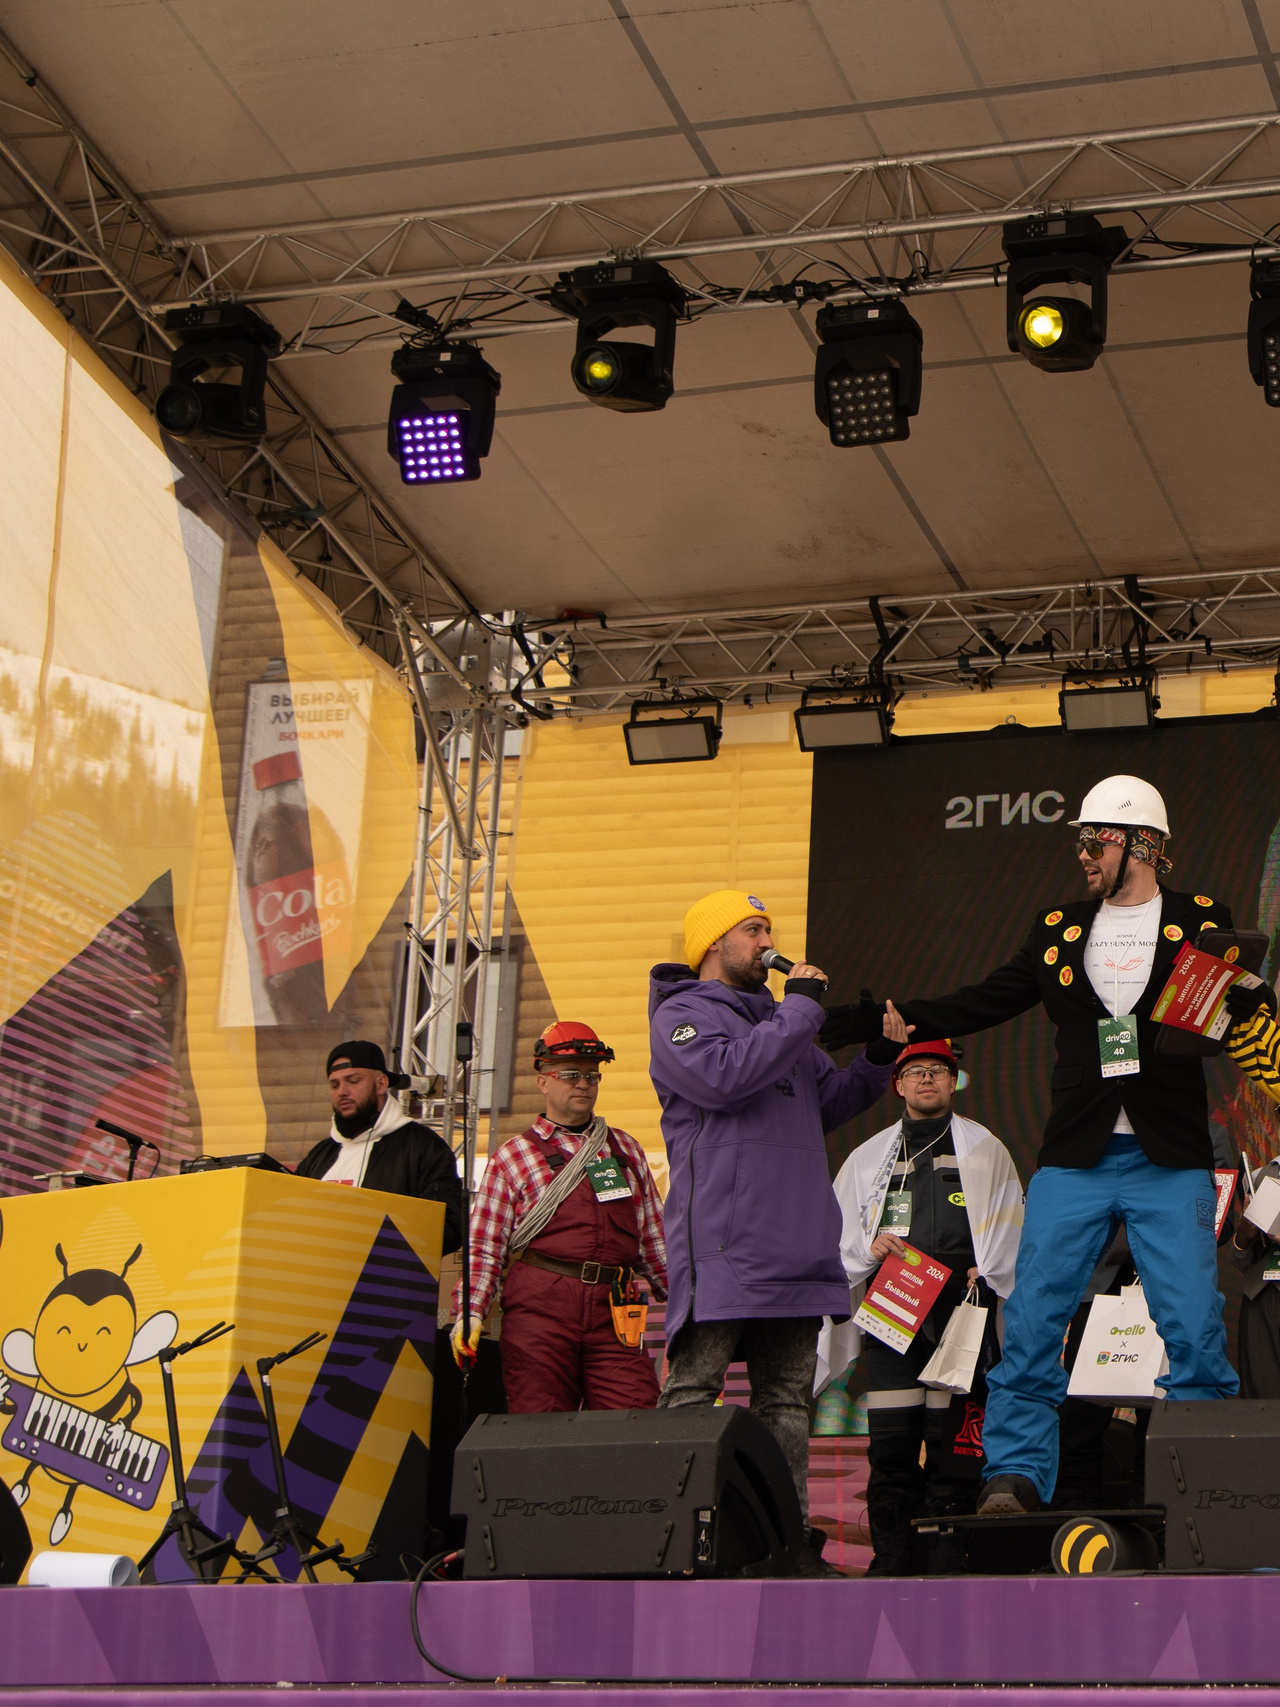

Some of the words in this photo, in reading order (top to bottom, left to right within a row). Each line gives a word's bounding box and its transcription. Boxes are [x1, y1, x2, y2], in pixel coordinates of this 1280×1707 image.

[270, 688, 360, 707] ВЫБИРАЙ
[271, 709, 350, 724] ЛУЧШЕЕ!
[279, 729, 345, 741] БОЧКАРИ
[945, 790, 1065, 829] 2ГИС
[257, 874, 347, 927] Cola
[1179, 954, 1197, 976] 2024
[1178, 973, 1197, 1004] ДИПЛОМ
[1181, 1004, 1195, 1022] Приз
[1191, 964, 1218, 1007] зрительских
[1194, 979, 1214, 1011] симпатий
[1113, 1047, 1125, 1056] 40
[900, 1268, 925, 1287] ДИПЛОМ
[926, 1265, 945, 1282] 2024
[884, 1280, 920, 1308] Бывалый
[1111, 1353, 1139, 1363] 2ГИС
[492, 1495, 668, 1517] ProTone
